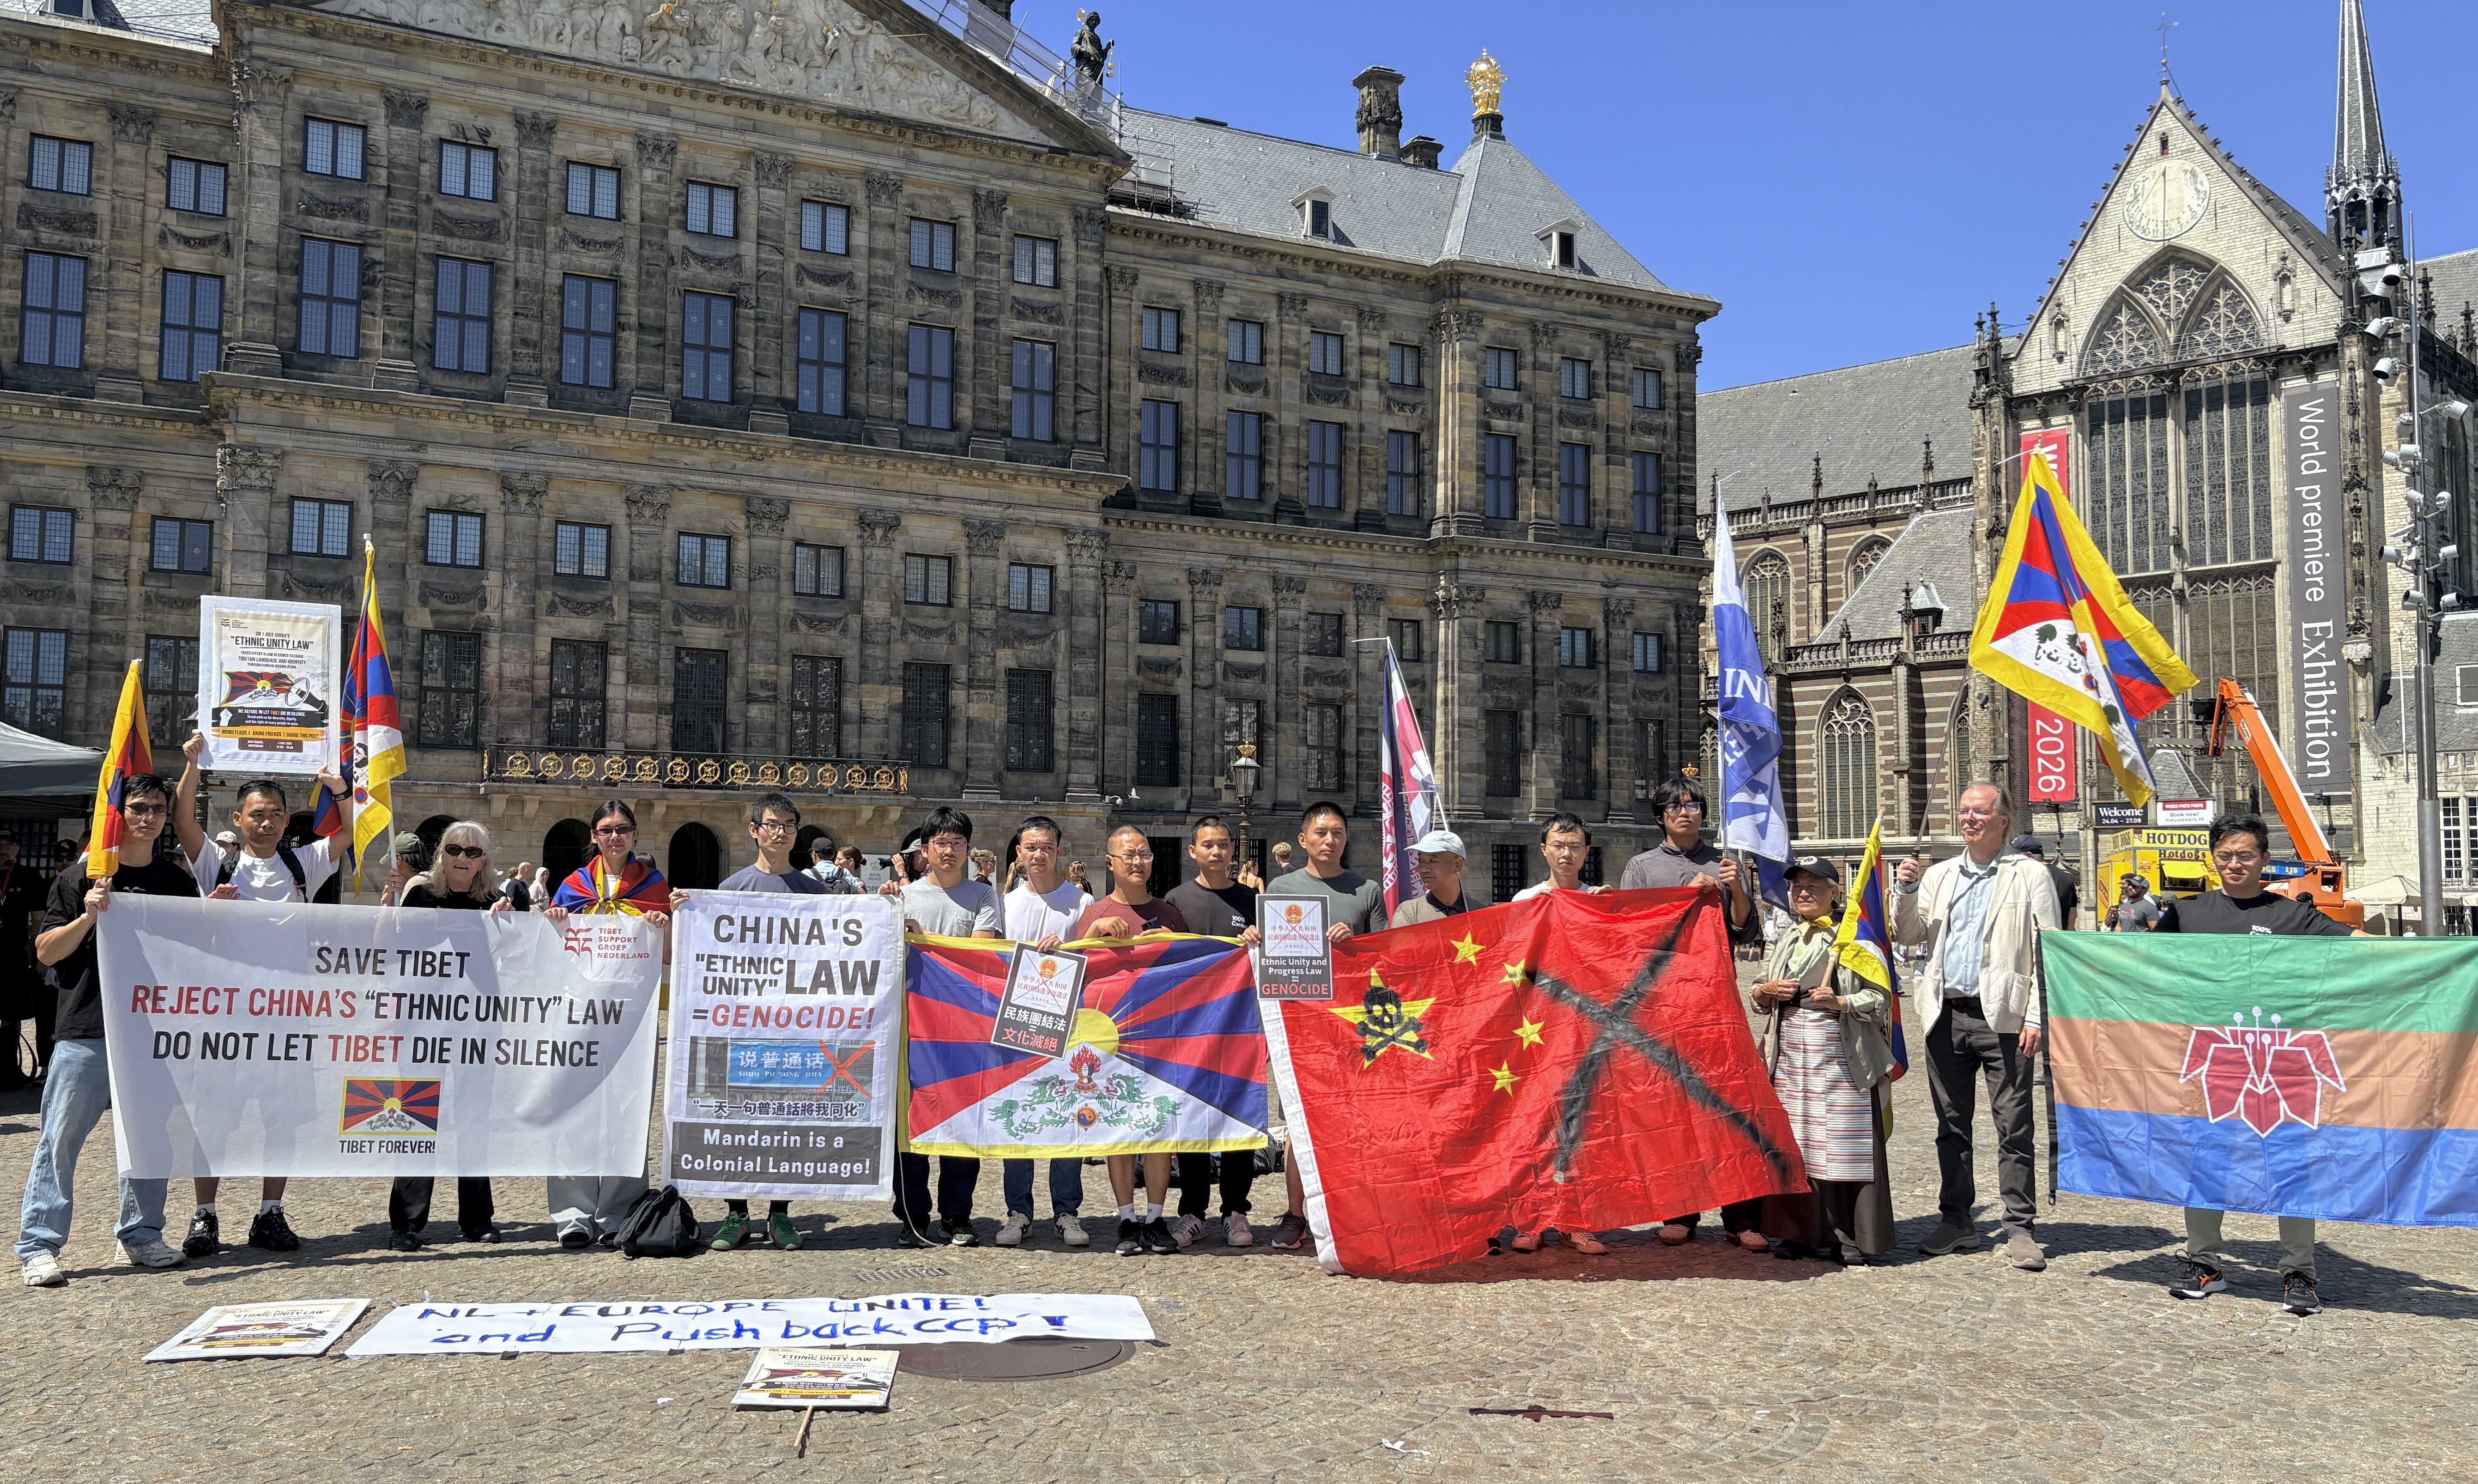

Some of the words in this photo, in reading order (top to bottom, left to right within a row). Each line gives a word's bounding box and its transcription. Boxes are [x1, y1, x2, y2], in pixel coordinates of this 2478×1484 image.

[2299, 397, 2327, 475] World
[2295, 484, 2330, 603] premiere
[231, 636, 264, 647] "ETHNIC
[267, 638, 291, 648] UNITY
[292, 640, 314, 649] LAW"
[2302, 619, 2339, 779] Exhibition
[2036, 718, 2065, 792] 2026
[2099, 807, 2144, 817] Welcome
[2159, 850, 2206, 860] Hotdogs
[713, 915, 863, 946] CHINA'S
[2252, 925, 2272, 933] 100%
[315, 947, 386, 976] SAVE
[398, 950, 471, 979] TIBET
[696, 953, 784, 975] "ETHNIC
[785, 959, 880, 996] LAW
[1269, 968, 1303, 976] Progress
[1288, 958, 1309, 967] Unity
[703, 976, 777, 996] UNITY"
[1023, 975, 1067, 990] 中华人共和国
[1262, 984, 1328, 995] GENOCIDE
[132, 985, 241, 1015] REJECT
[248, 988, 357, 1018] CHINA’S
[365, 991, 469, 1022] “ETHNIC
[474, 995, 562, 1024] UNITY”
[568, 999, 624, 1026] LAW
[1004, 1006, 1066, 1032] 民族團結法
[153, 1031, 191, 1060] DO
[200, 1032, 259, 1061] NOT
[268, 1034, 318, 1062] LET
[329, 1034, 404, 1064] TIBET
[412, 1036, 451, 1065] DIE
[460, 1037, 486, 1066] IN
[495, 1039, 599, 1067] SILENCE
[1002, 1028, 1058, 1052] 文化滅絕
[739, 1051, 825, 1069] 说普通话
[339, 1139, 373, 1154] TIBET
[377, 1140, 436, 1154] FOREVER!
[703, 1128, 800, 1148] Mandarin
[809, 1132, 827, 1148] is
[833, 1134, 844, 1148] a
[680, 1153, 762, 1173] Colonial
[769, 1157, 871, 1179] Language!
[418, 1308, 496, 1320] NL
[559, 1305, 786, 1318] EUROPE
[829, 1296, 994, 1313] UNITE!
[430, 1325, 556, 1344] and
[611, 1319, 760, 1342] Push
[781, 1317, 907, 1339] back
[913, 1318, 1018, 1335] CCP
